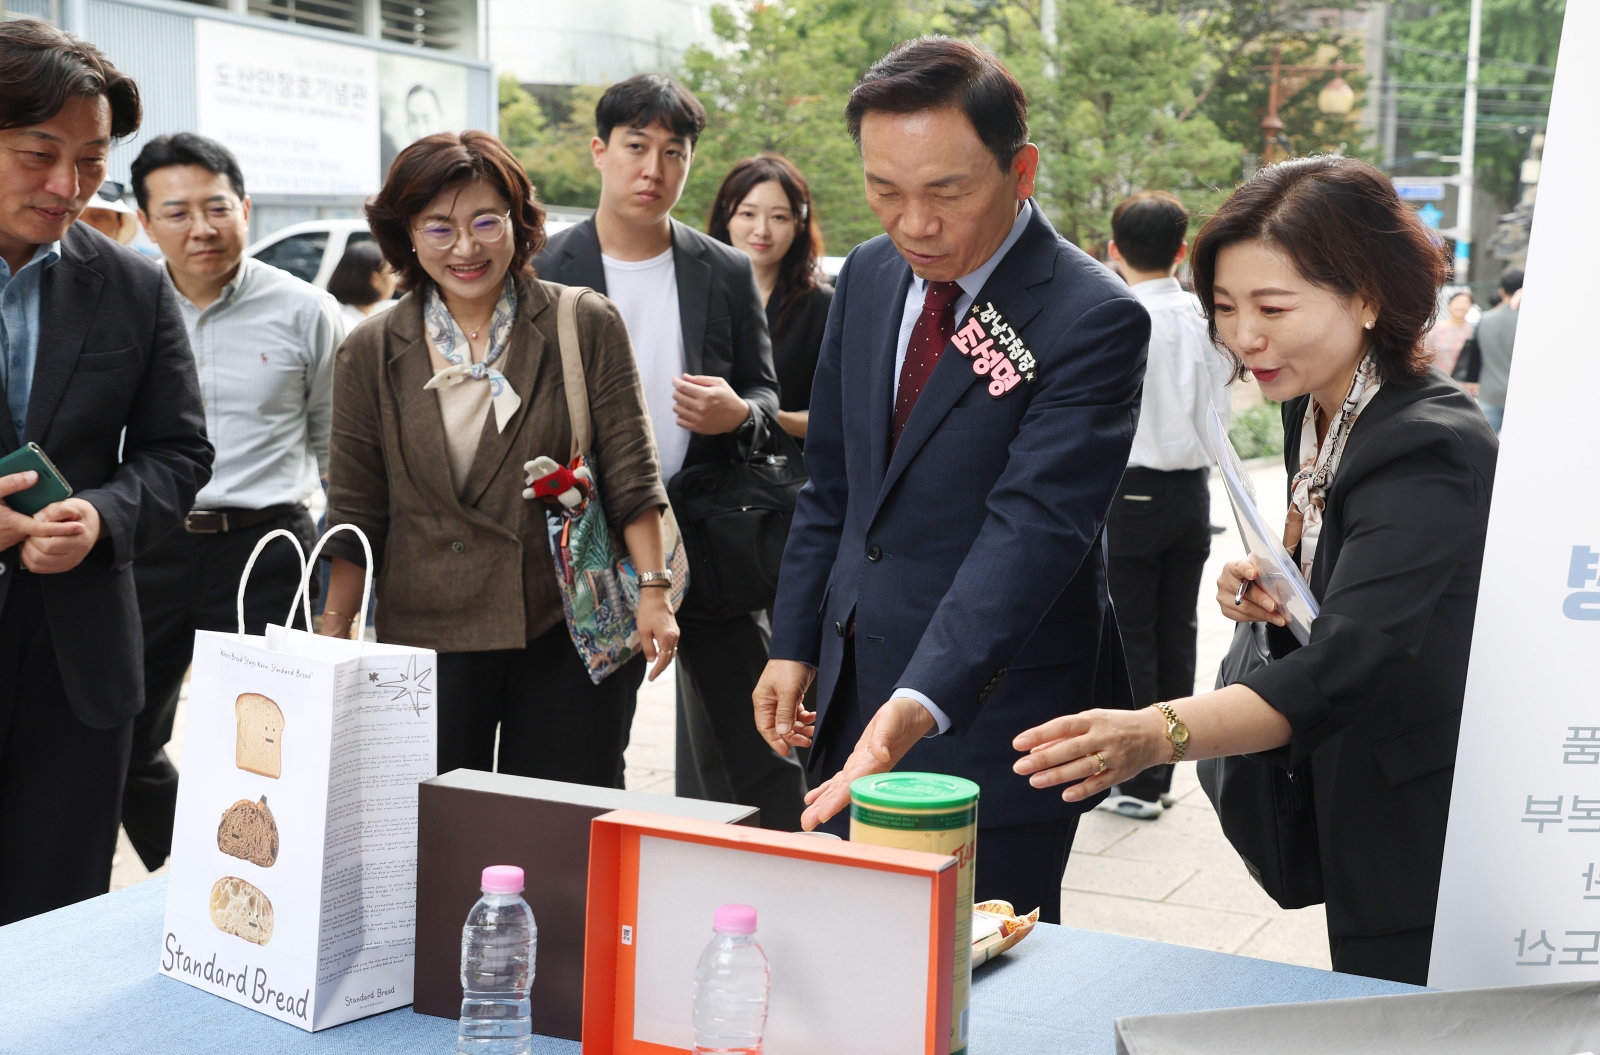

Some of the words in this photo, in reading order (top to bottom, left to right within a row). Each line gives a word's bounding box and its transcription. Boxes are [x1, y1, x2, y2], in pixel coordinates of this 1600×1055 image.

[950, 316, 1022, 397] 조성명
[979, 301, 1037, 372] 강남구청장
[162, 932, 248, 996] Standard
[251, 967, 310, 1021] Bread
[344, 990, 374, 1006] Standard
[377, 986, 396, 998] Bread
